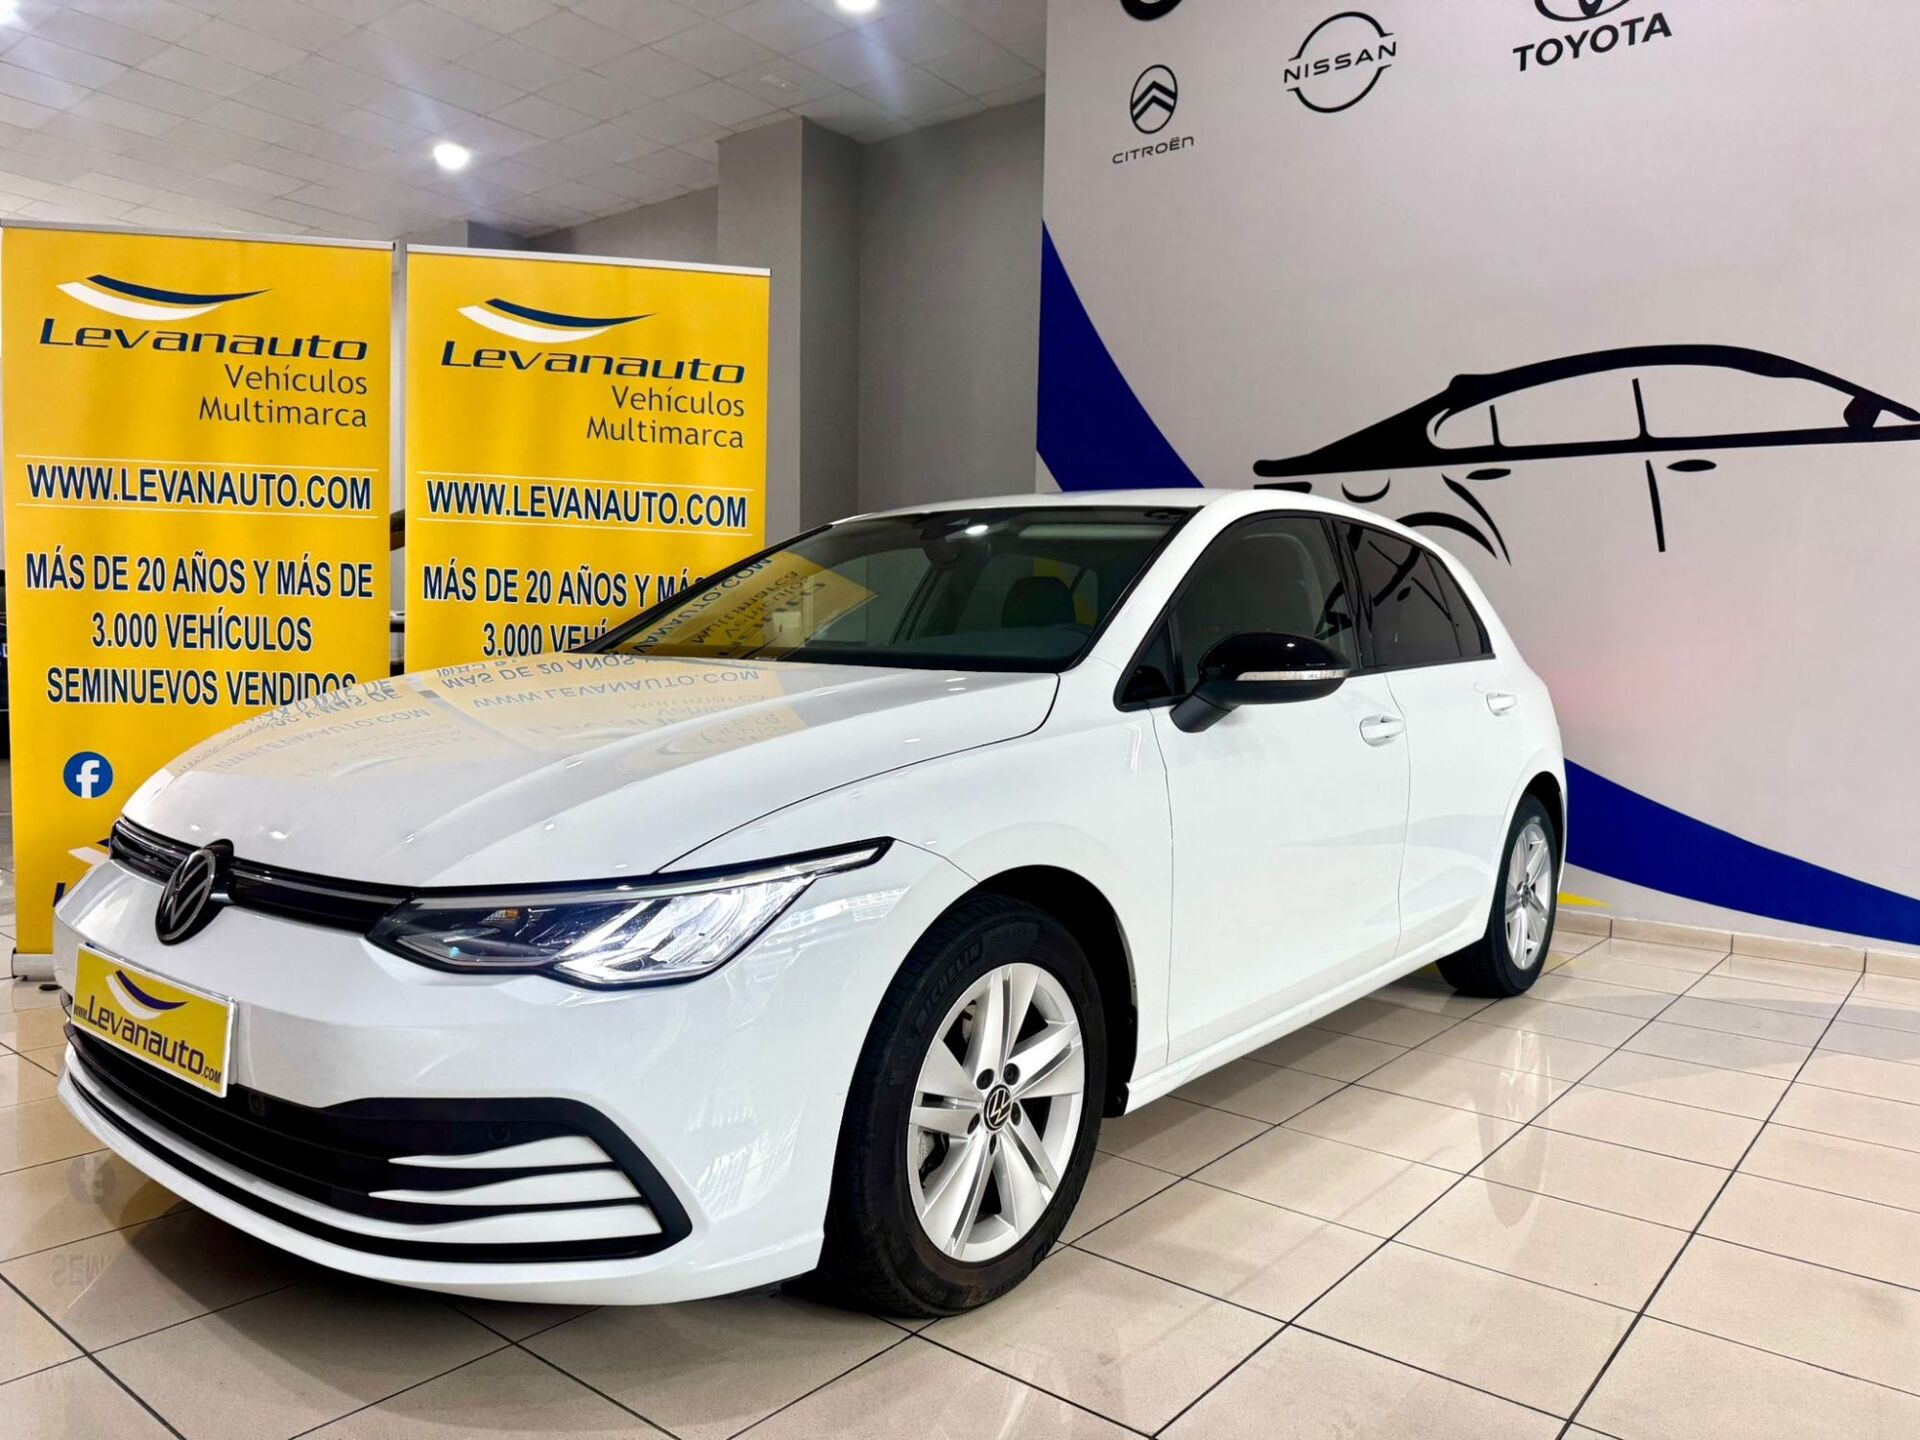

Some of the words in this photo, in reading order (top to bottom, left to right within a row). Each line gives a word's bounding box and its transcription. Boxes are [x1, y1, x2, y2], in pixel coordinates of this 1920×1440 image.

[1283, 41, 1397, 84] NISSAN
[1511, 12, 1673, 73] TOYOTA
[39, 318, 367, 361] Levanauto
[224, 363, 367, 395] Vehículos
[441, 340, 745, 384] Levanauto
[199, 396, 367, 428] Multimarca
[611, 385, 745, 418] Vehículos
[586, 416, 744, 449] Multimarca
[27, 463, 371, 511] WWW.LEVANAUTO.COM
[426, 480, 746, 529] WWW.LEVANAUTO.COM
[26, 545, 85, 590] MÁS
[93, 554, 128, 592] DE
[137, 556, 165, 593] 20
[173, 551, 246, 594] AÑOS
[253, 559, 270, 595] Y
[277, 553, 331, 598] MÁS
[339, 562, 374, 598] DE
[423, 558, 477, 603] MÁS
[485, 568, 518, 604] DE
[525, 570, 552, 605] 20
[557, 564, 627, 608] AÑOS
[634, 574, 651, 609] Y
[657, 568, 706, 603] MÁ
[92, 611, 157, 649] 3.000
[165, 606, 312, 653] VEHÍCULOS
[483, 622, 543, 658] 3.000
[47, 667, 218, 706] SEMINUEVOS
